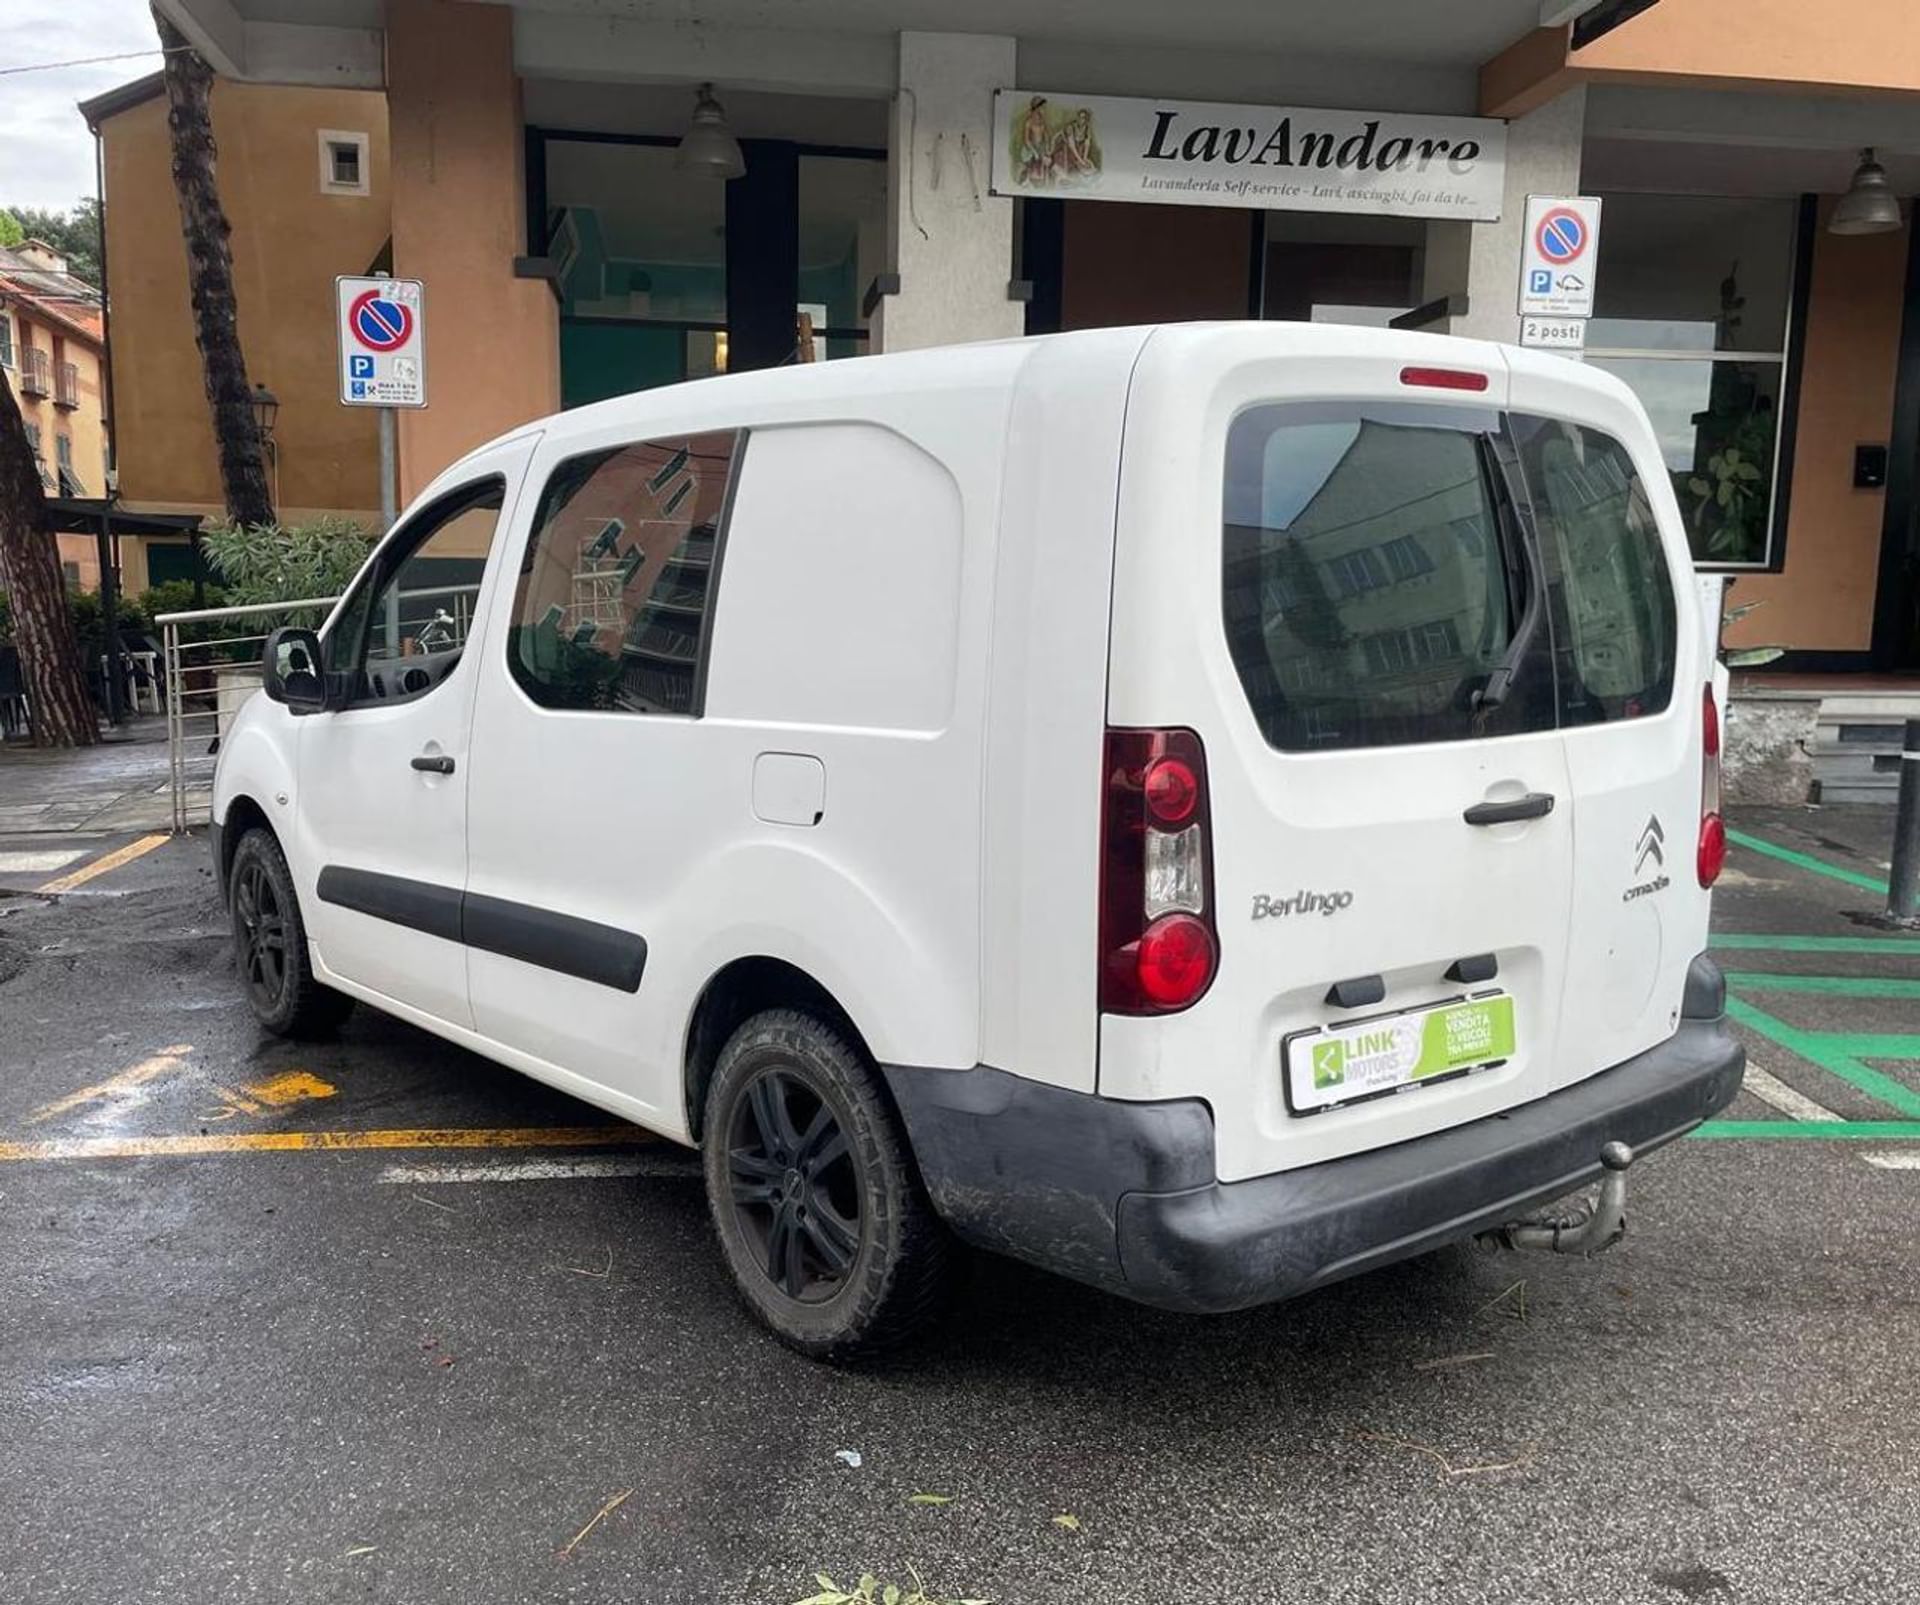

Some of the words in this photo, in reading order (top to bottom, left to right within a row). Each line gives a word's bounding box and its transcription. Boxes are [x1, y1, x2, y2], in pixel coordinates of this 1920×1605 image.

[1142, 111, 1480, 176] LavAndare
[1141, 175, 1220, 192] Lavanderia
[1223, 179, 1300, 198] Self-service
[1535, 272, 1549, 292] P
[1527, 323, 1537, 337] 2
[1541, 325, 1580, 341] posti
[355, 358, 369, 376] P
[1251, 890, 1354, 920] Berlingo
[1344, 1029, 1396, 1060] LINK
[1345, 1053, 1399, 1081] MOTORS
